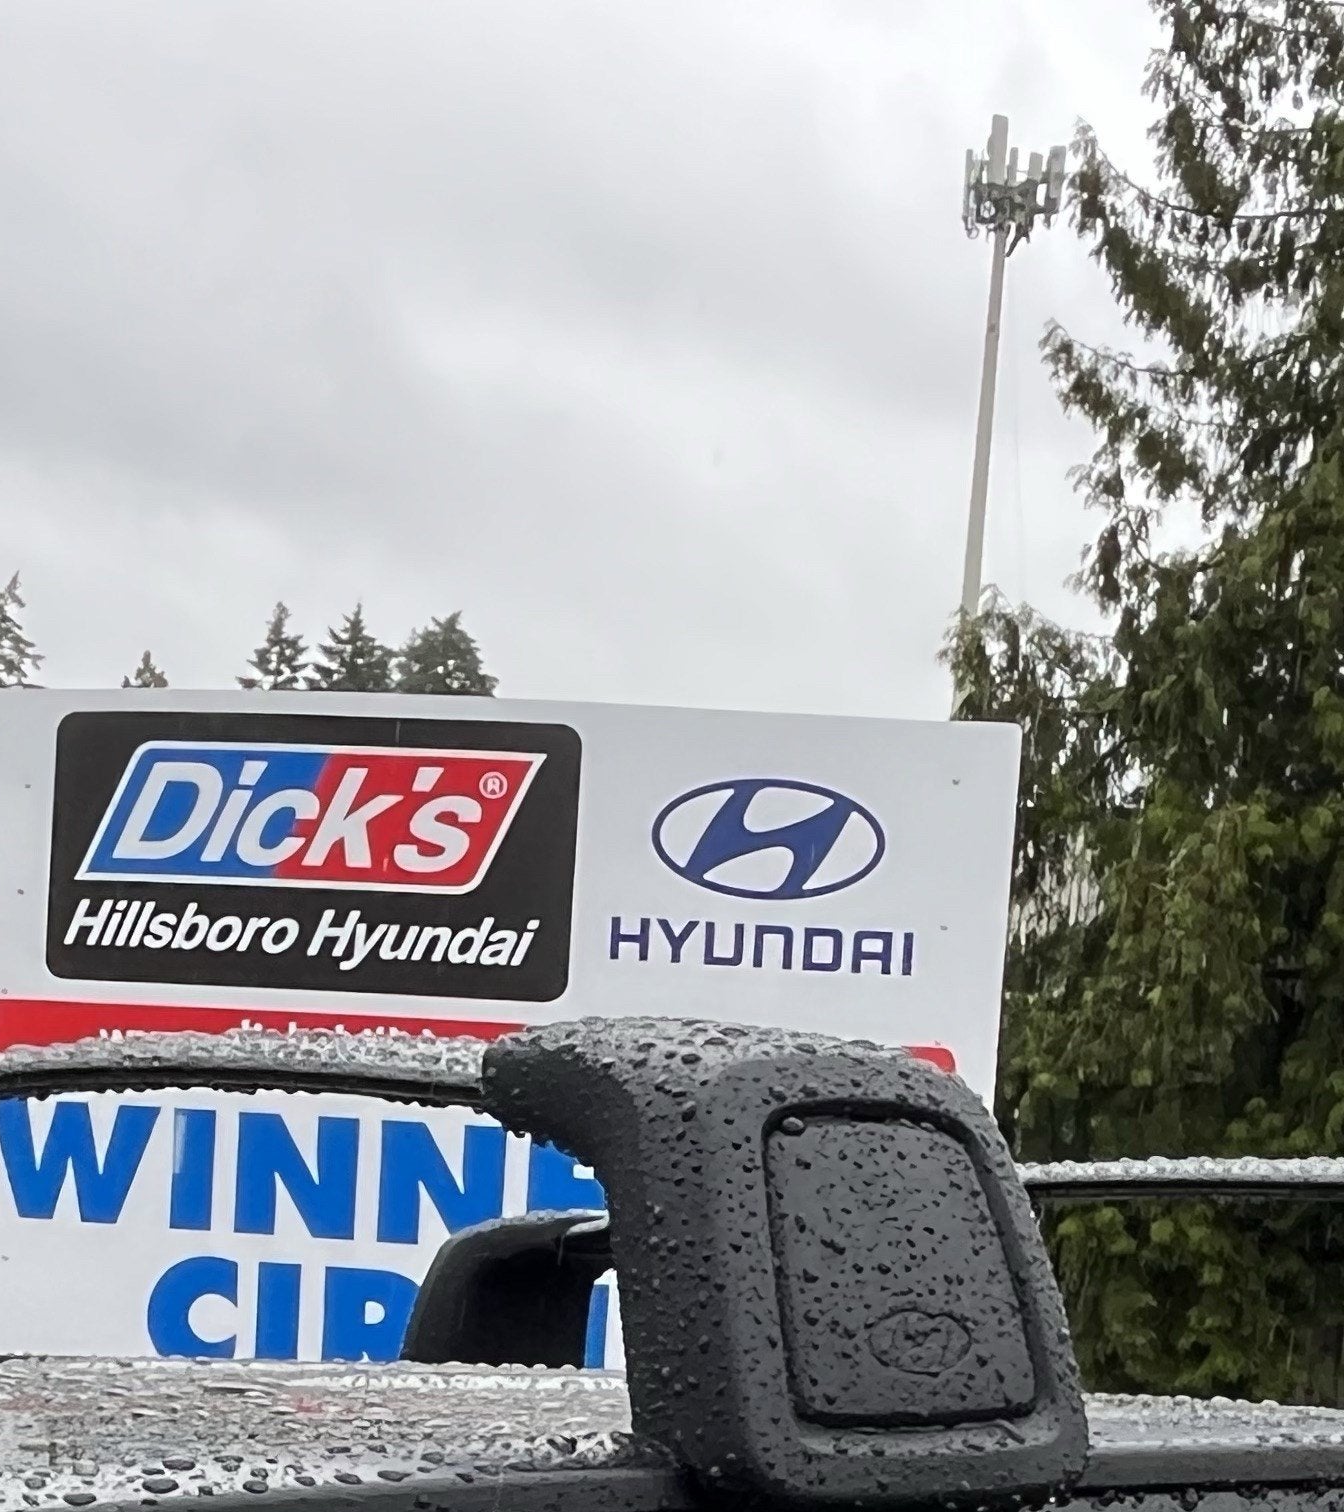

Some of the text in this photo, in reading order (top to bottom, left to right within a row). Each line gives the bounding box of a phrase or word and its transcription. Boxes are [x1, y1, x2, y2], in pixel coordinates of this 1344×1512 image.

[63, 898, 541, 971] Hillsboro Hyundai
[609, 916, 914, 976] HYUNDAI
